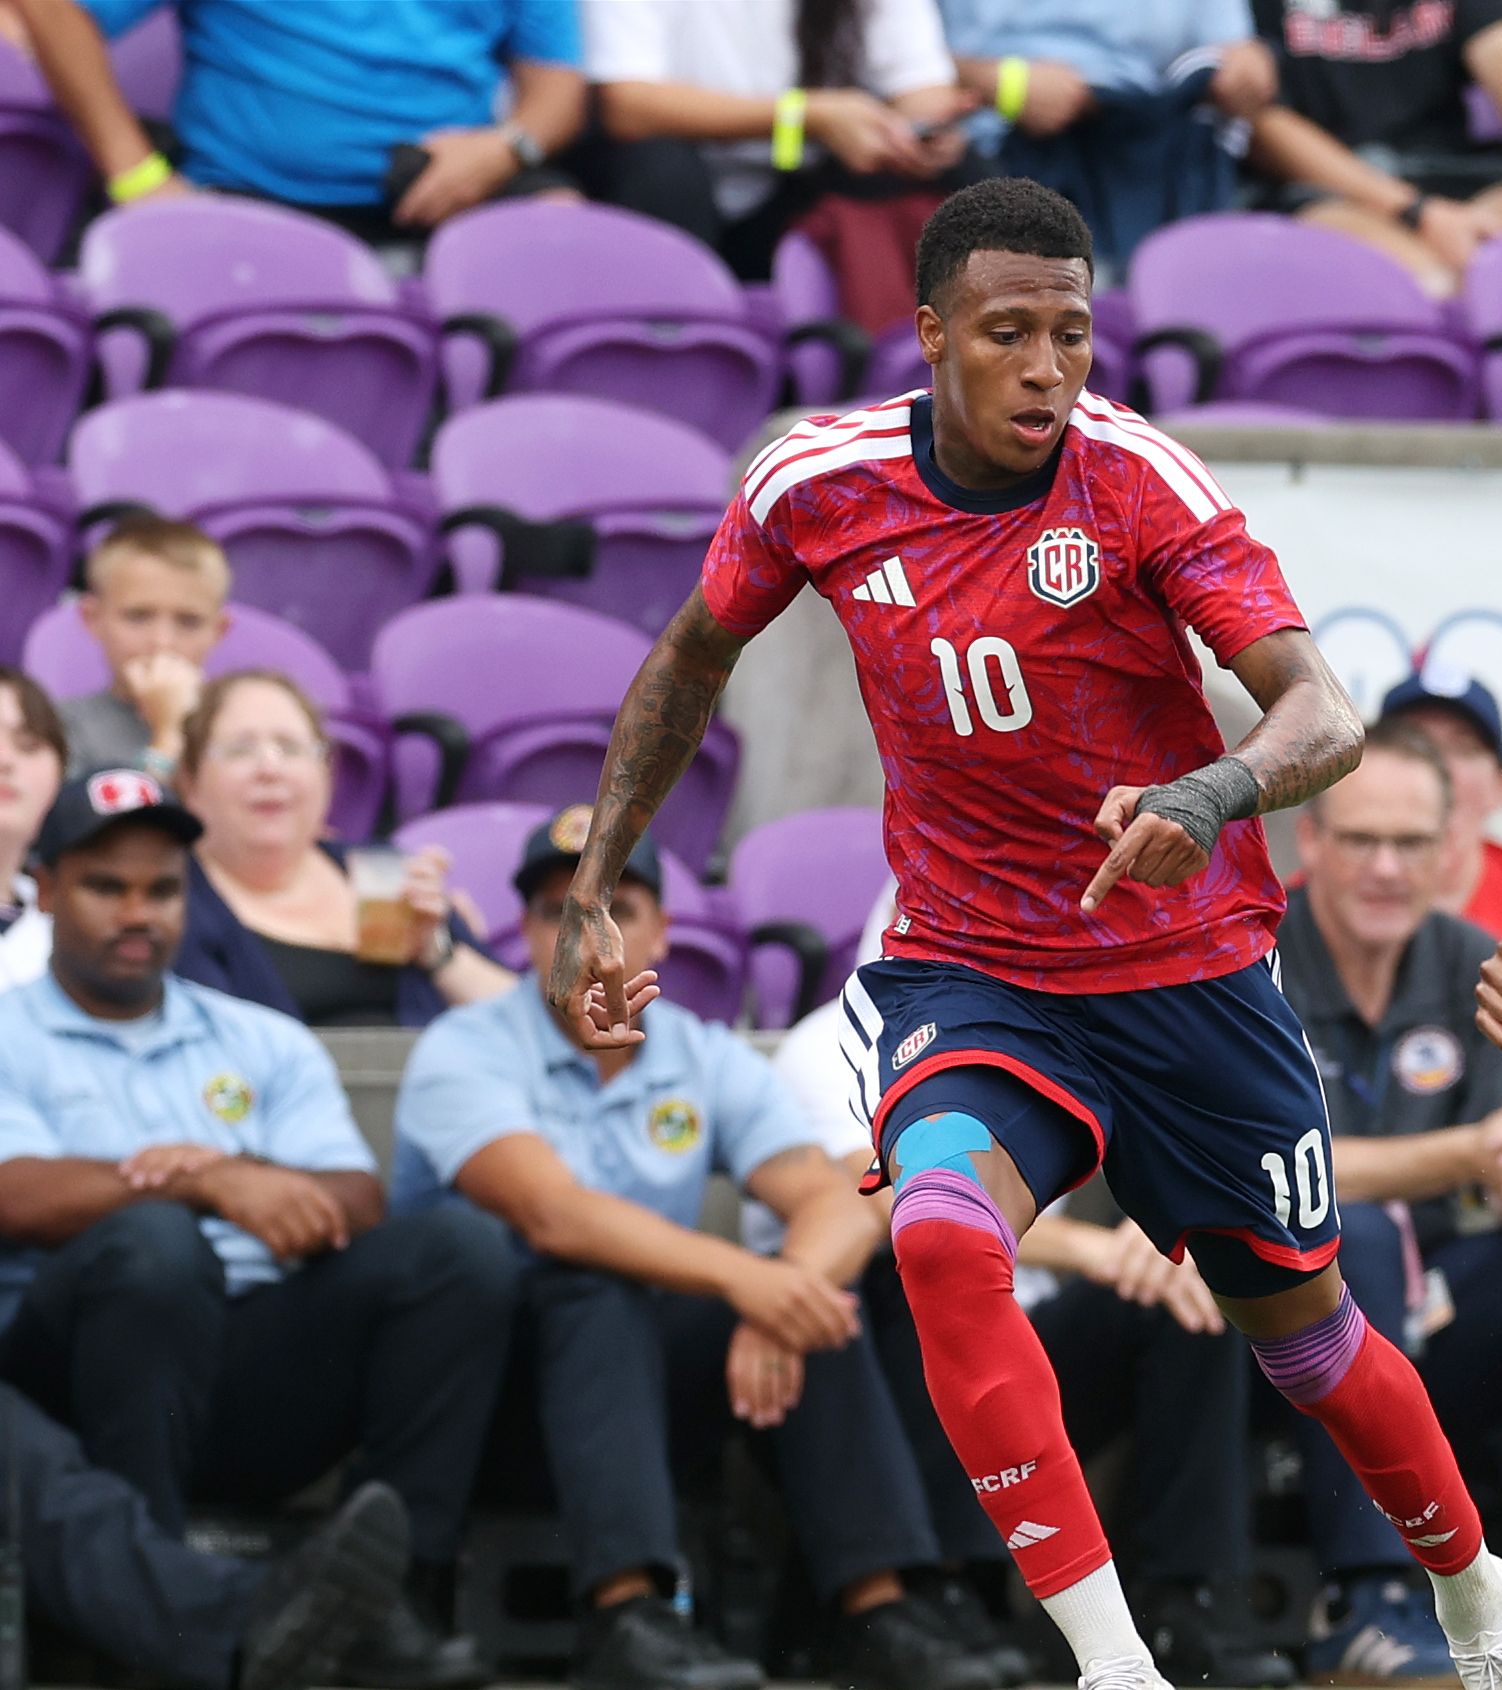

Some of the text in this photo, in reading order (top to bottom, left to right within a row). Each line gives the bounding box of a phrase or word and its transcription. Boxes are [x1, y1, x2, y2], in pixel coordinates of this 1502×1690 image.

[1044, 543, 1083, 593] CR
[930, 636, 1033, 736] 10
[901, 1030, 925, 1060] CR
[1261, 1128, 1329, 1229] 10
[970, 1459, 1038, 1495] FCRF
